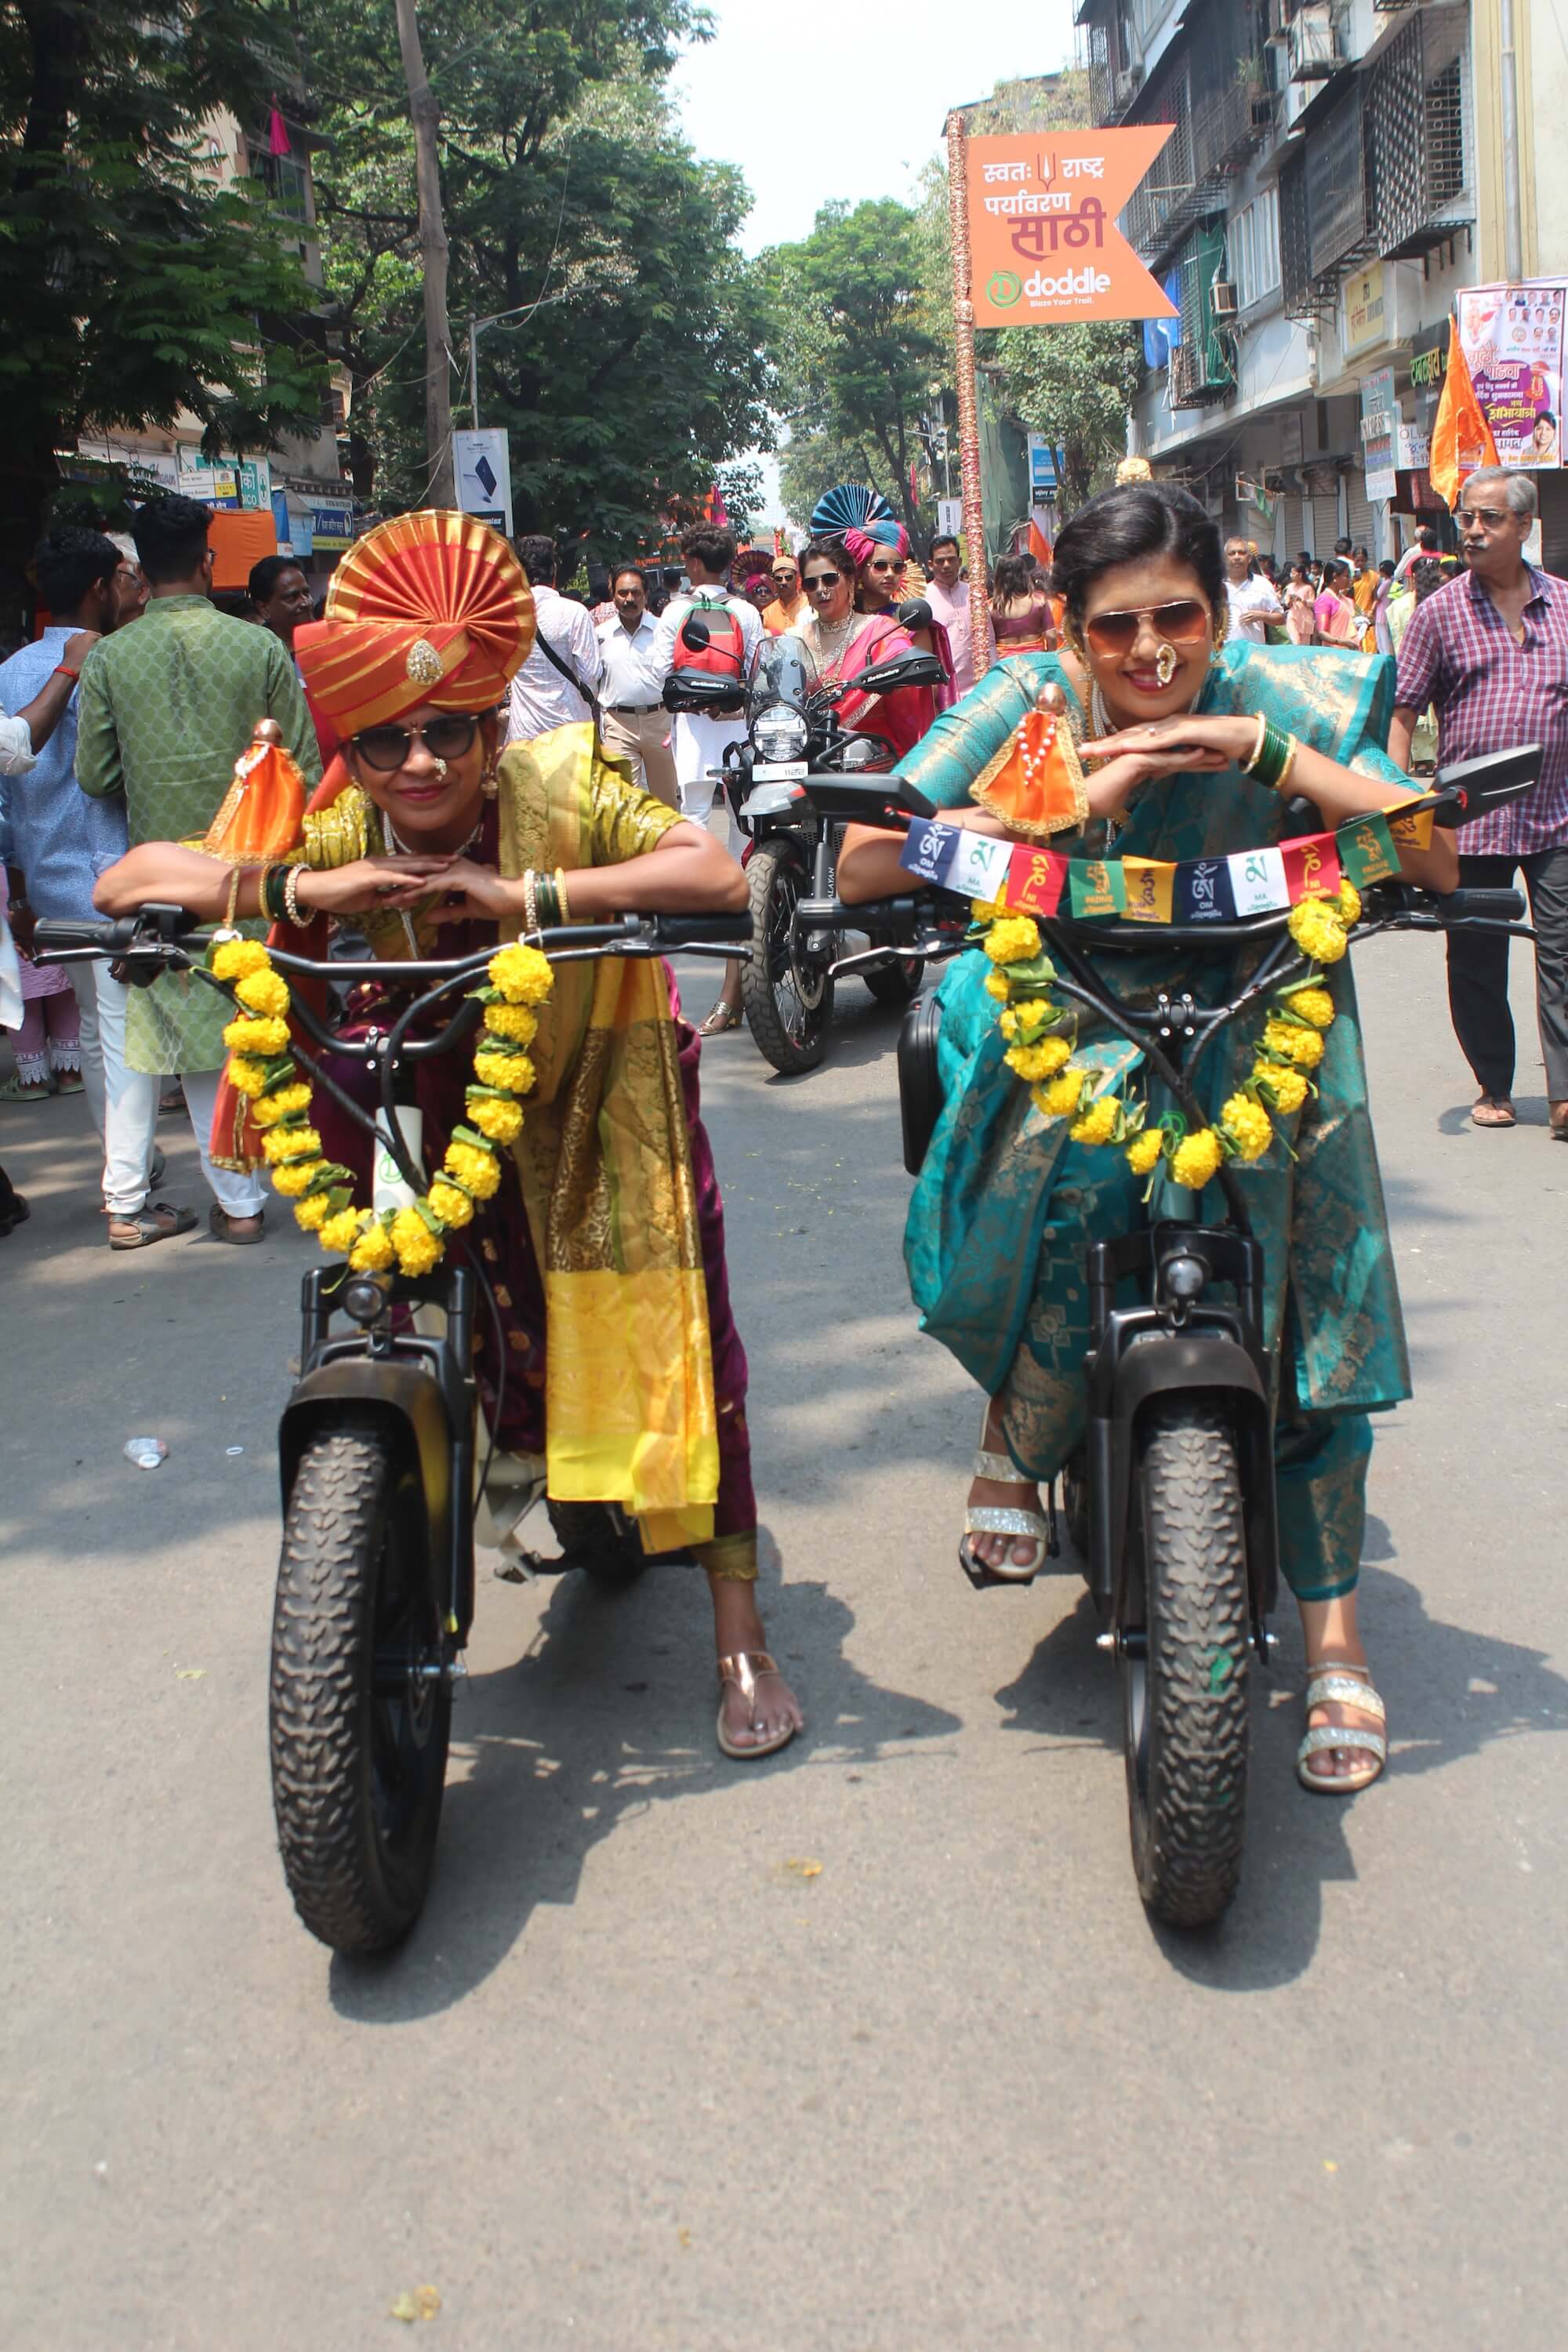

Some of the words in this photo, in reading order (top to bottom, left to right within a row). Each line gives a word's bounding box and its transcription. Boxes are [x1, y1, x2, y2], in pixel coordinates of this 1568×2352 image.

[982, 162, 1032, 183] स्वतः
[1061, 157, 1105, 179] राष्ट्र
[984, 189, 1072, 216] पर्यावरण
[1007, 197, 1107, 262] साठी
[1024, 267, 1111, 297] doddle
[1029, 299, 1051, 307] Blaze
[920, 858, 935, 869] OM
[968, 877, 980, 886] MA
[1309, 879, 1321, 888] NI
[1026, 893, 1037, 902] NI
